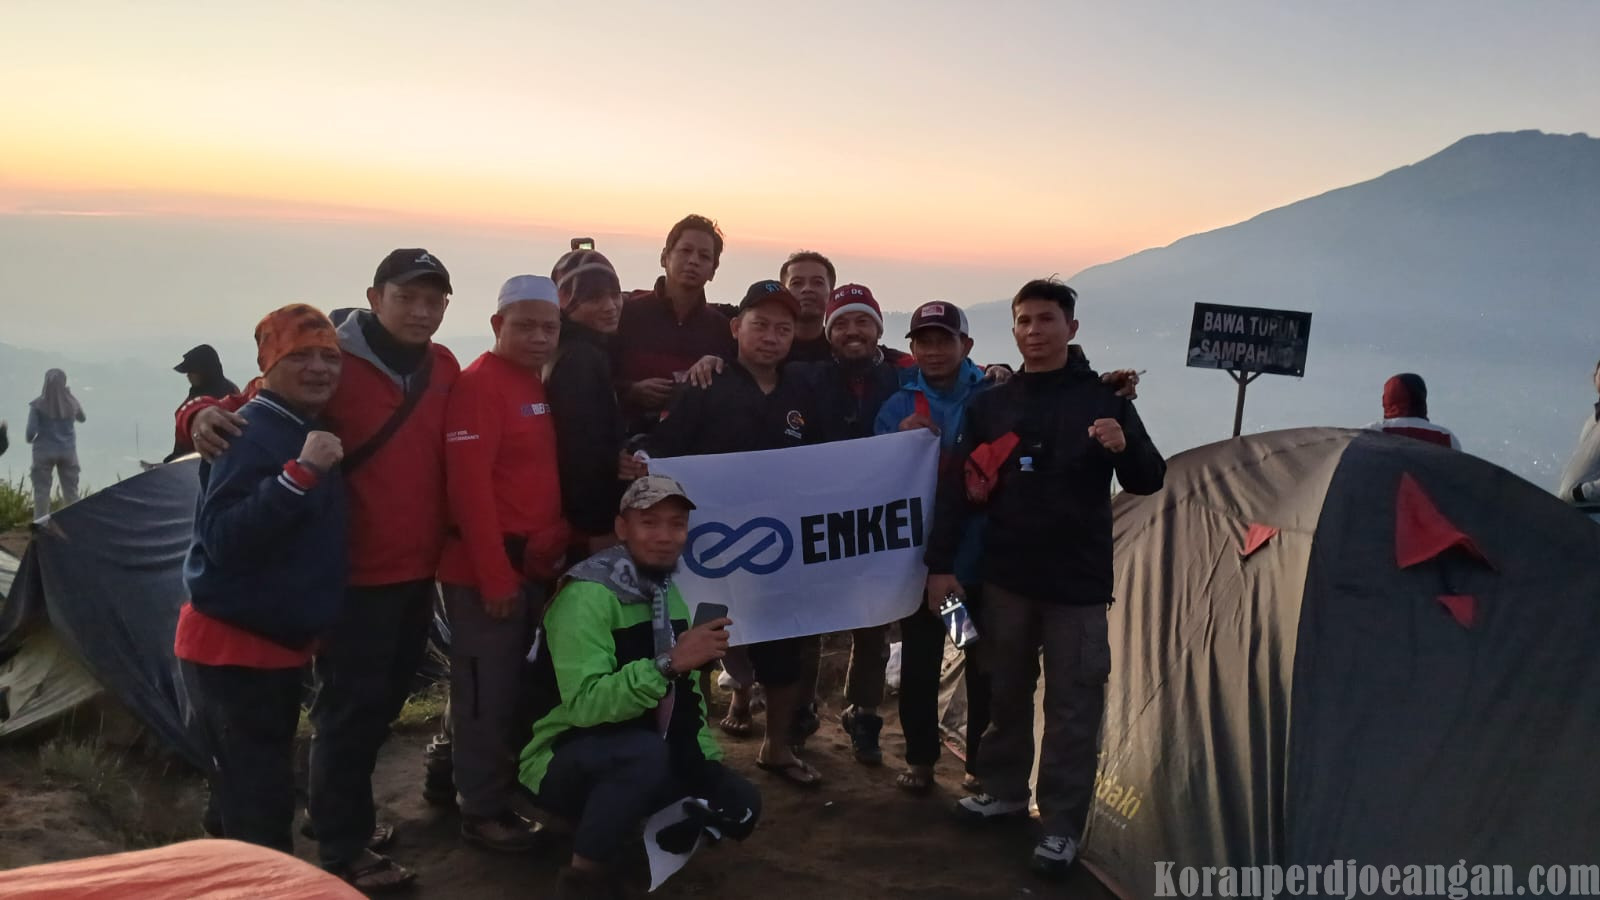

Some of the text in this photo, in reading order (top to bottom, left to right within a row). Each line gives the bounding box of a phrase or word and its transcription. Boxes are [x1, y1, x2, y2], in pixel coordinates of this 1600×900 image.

[1203, 312, 1299, 339] BAWA TURUN
[800, 496, 923, 565] ENKEI
